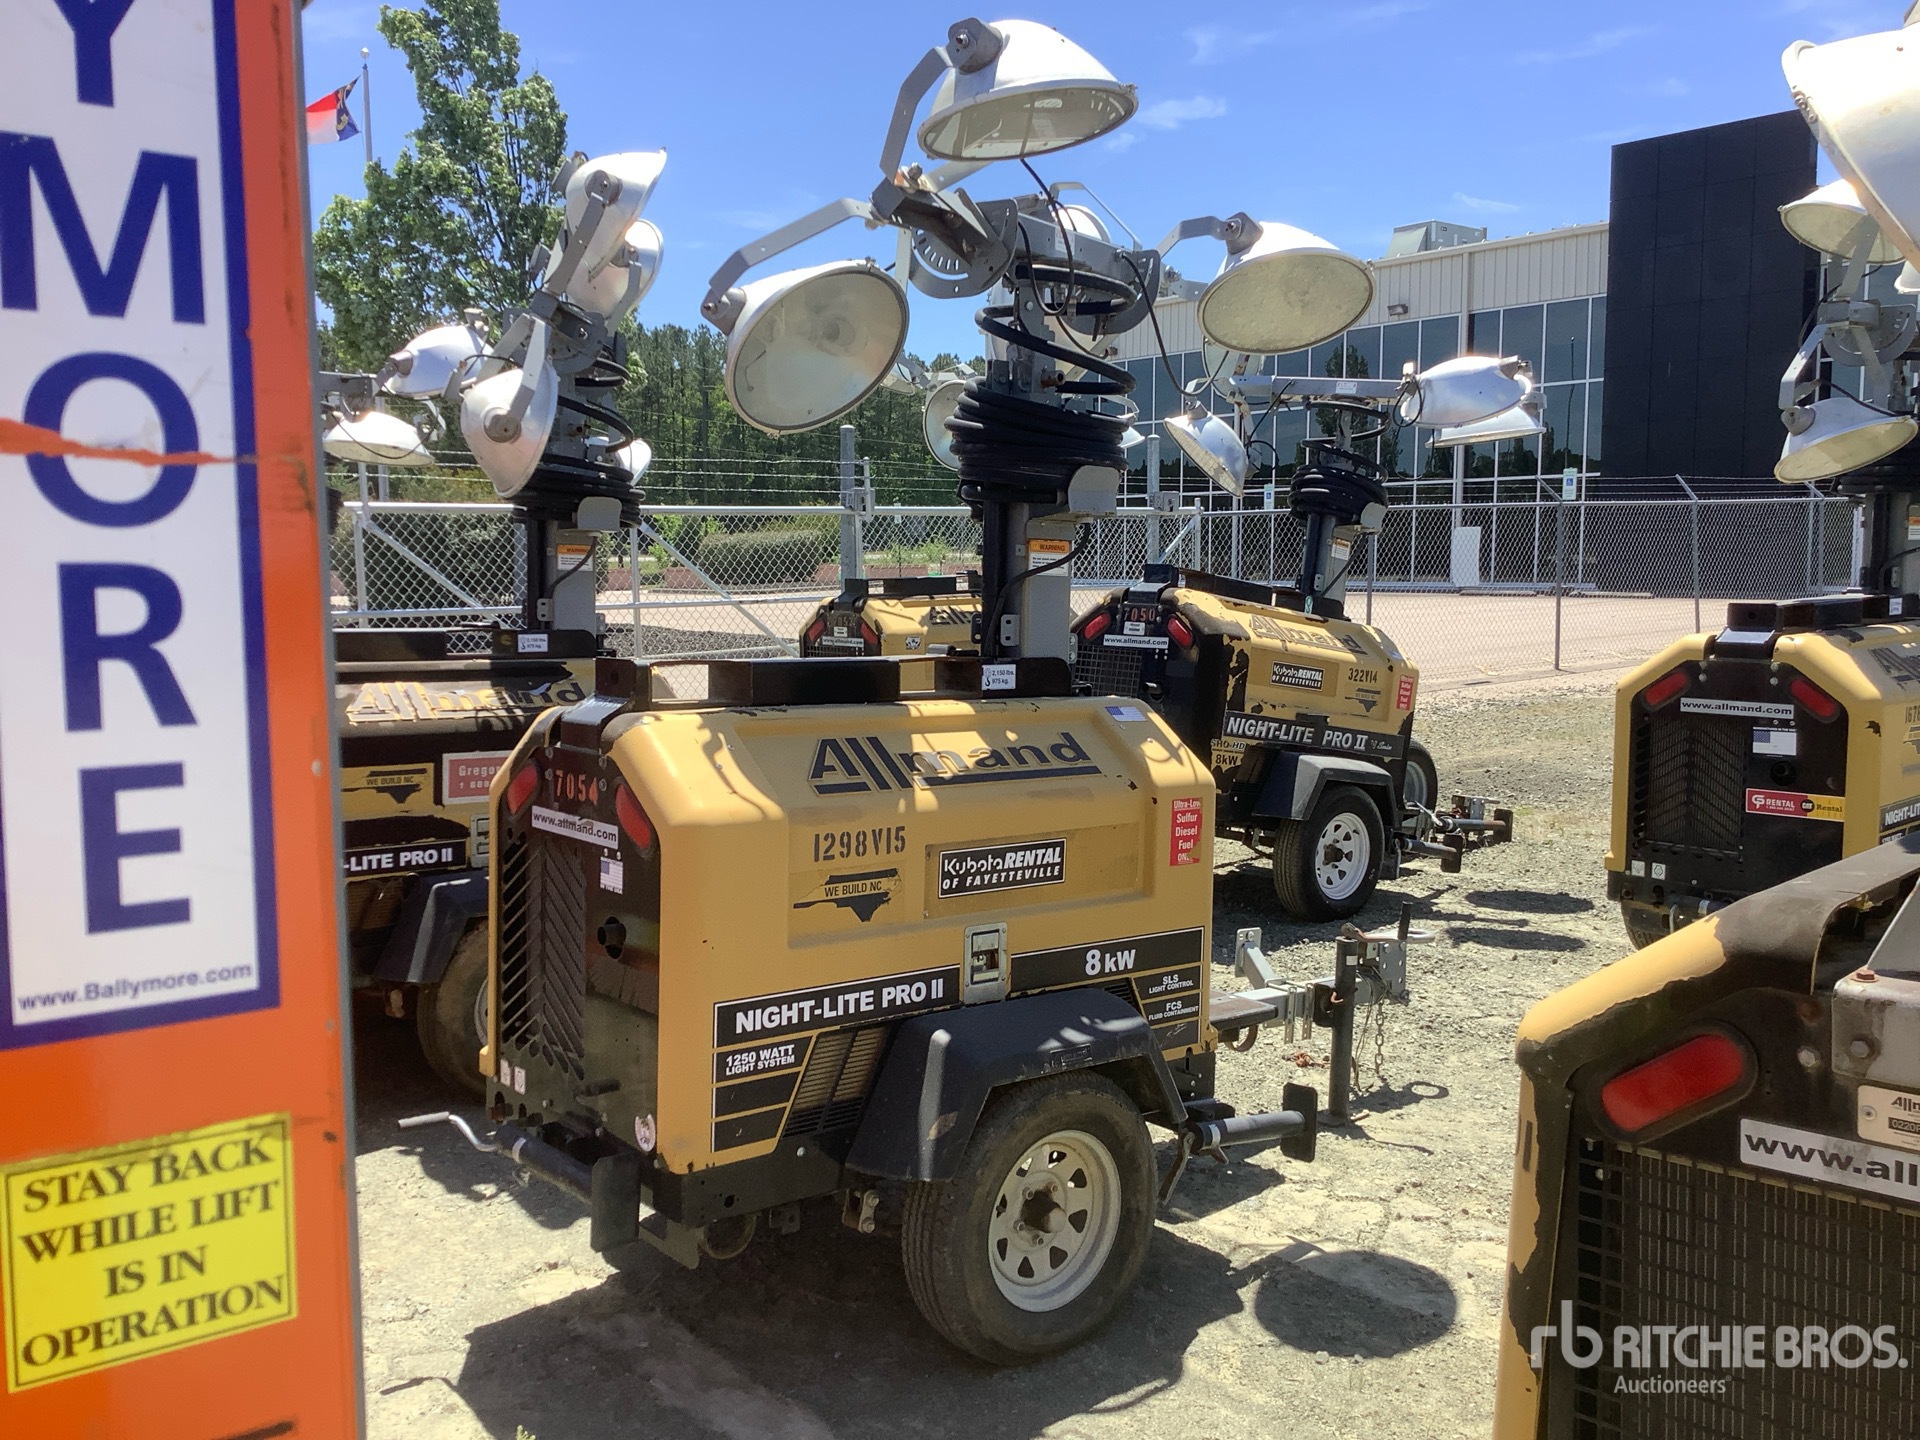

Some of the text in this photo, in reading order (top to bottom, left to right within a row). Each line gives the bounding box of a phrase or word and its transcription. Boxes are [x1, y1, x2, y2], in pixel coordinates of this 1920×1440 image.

[1124, 607, 1156, 622] 7050
[1104, 637, 1168, 646] www.allmand.com
[1682, 701, 1792, 715] www.allmand.com
[1226, 716, 1314, 743] NIGHT-LITE
[1322, 730, 1353, 748] PRO
[1353, 735, 1368, 751] II
[808, 731, 1093, 791] Allmand
[1215, 754, 1238, 766] 8kW
[366, 778, 378, 786] WE
[556, 769, 598, 806] 7054
[1766, 799, 1795, 808] RENTAL
[1801, 802, 1814, 810] CAT
[1816, 803, 1843, 812] Rental
[1176, 812, 1198, 823] Sulfur
[1175, 825, 1198, 837] Diesel
[813, 825, 906, 863] 1298V15
[1178, 839, 1194, 850] Fuel
[399, 850, 438, 867] PRO
[441, 848, 453, 862] II
[942, 865, 1061, 890] OF FAYETTEVILLE
[824, 880, 882, 898] WE BUILD NC
[1085, 949, 1136, 976] 8 kW
[18, 963, 253, 1011] www.Ballymore.com
[1148, 980, 1194, 994] LIGHT CONTROL
[1162, 974, 1179, 985] SLS
[735, 978, 944, 1034] NIGHT-LITE PRO II
[1148, 1005, 1199, 1020] FLUID CONTAINMENT
[1166, 1001, 1183, 1011] FCS
[725, 1054, 795, 1076] LIGHT SYSTEM
[726, 1044, 795, 1068] 1250 WATT
[23, 1133, 275, 1214] STAY BACK
[18, 1179, 281, 1264] WHILE LIFT
[103, 1245, 209, 1299] IS IN
[22, 1275, 285, 1367] OPERATION
